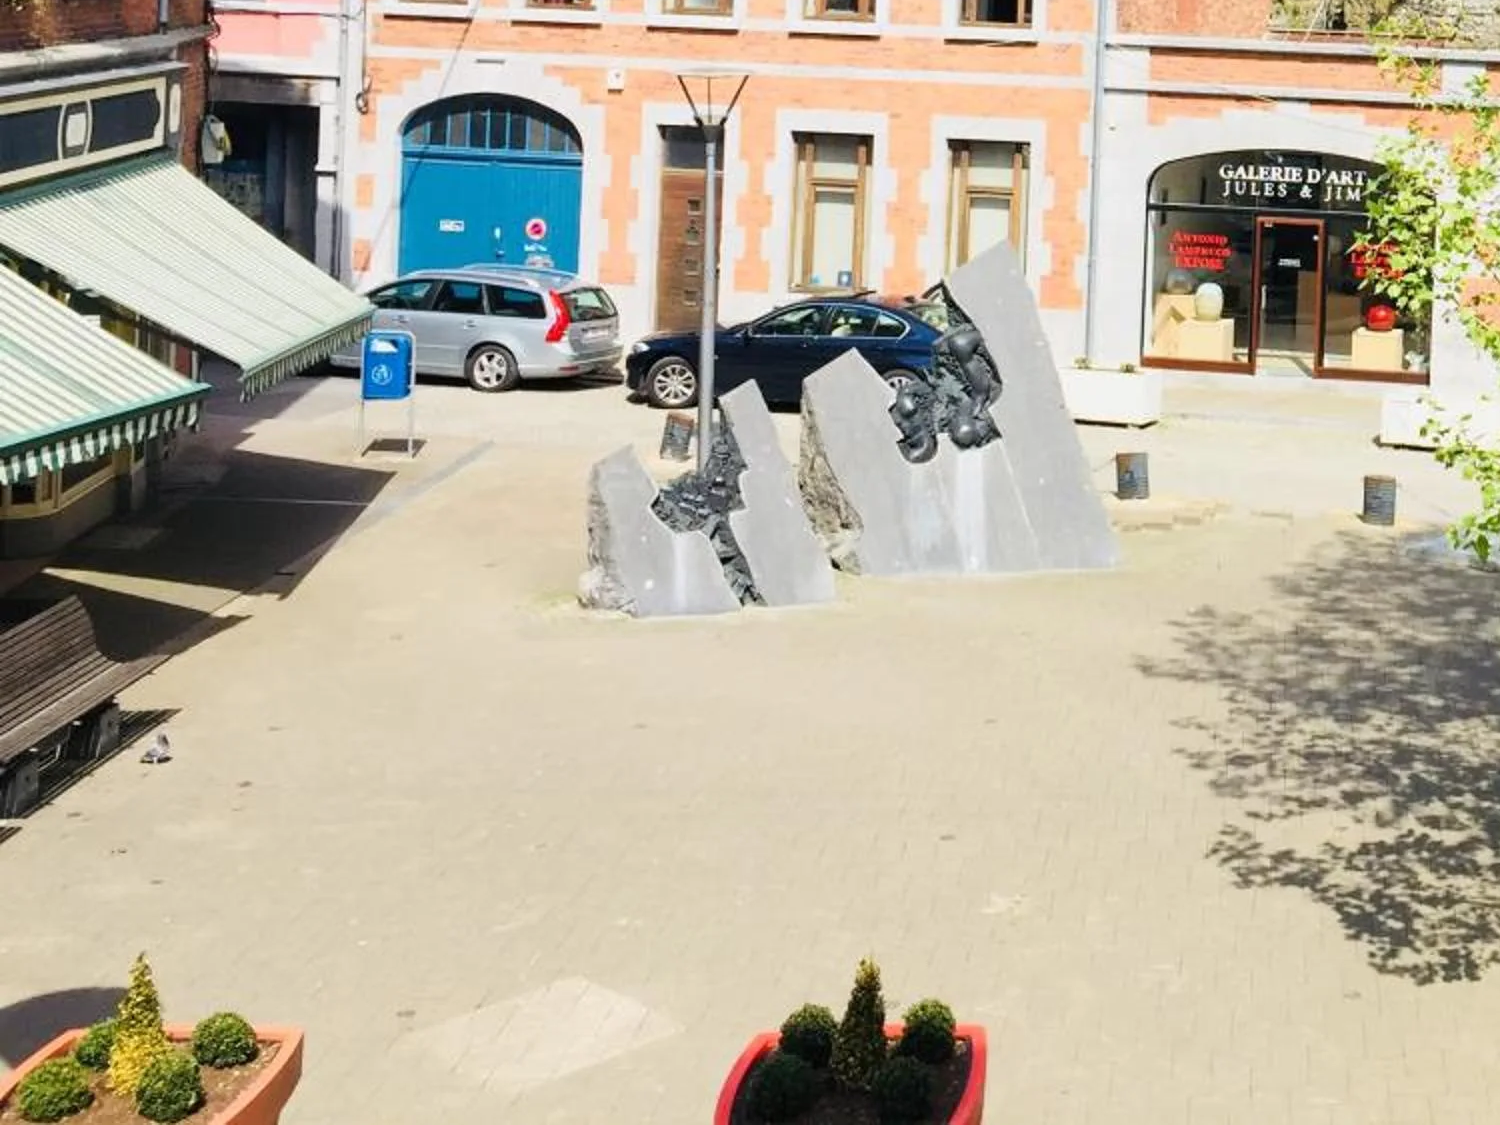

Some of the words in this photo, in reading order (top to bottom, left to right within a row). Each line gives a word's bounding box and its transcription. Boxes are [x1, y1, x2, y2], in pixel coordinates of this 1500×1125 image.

[1218, 164, 1302, 182] GALERIE
[1306, 168, 1367, 186] D'ART
[1222, 180, 1287, 198] JULES
[1300, 184, 1313, 199] &
[1323, 186, 1361, 202] JIM
